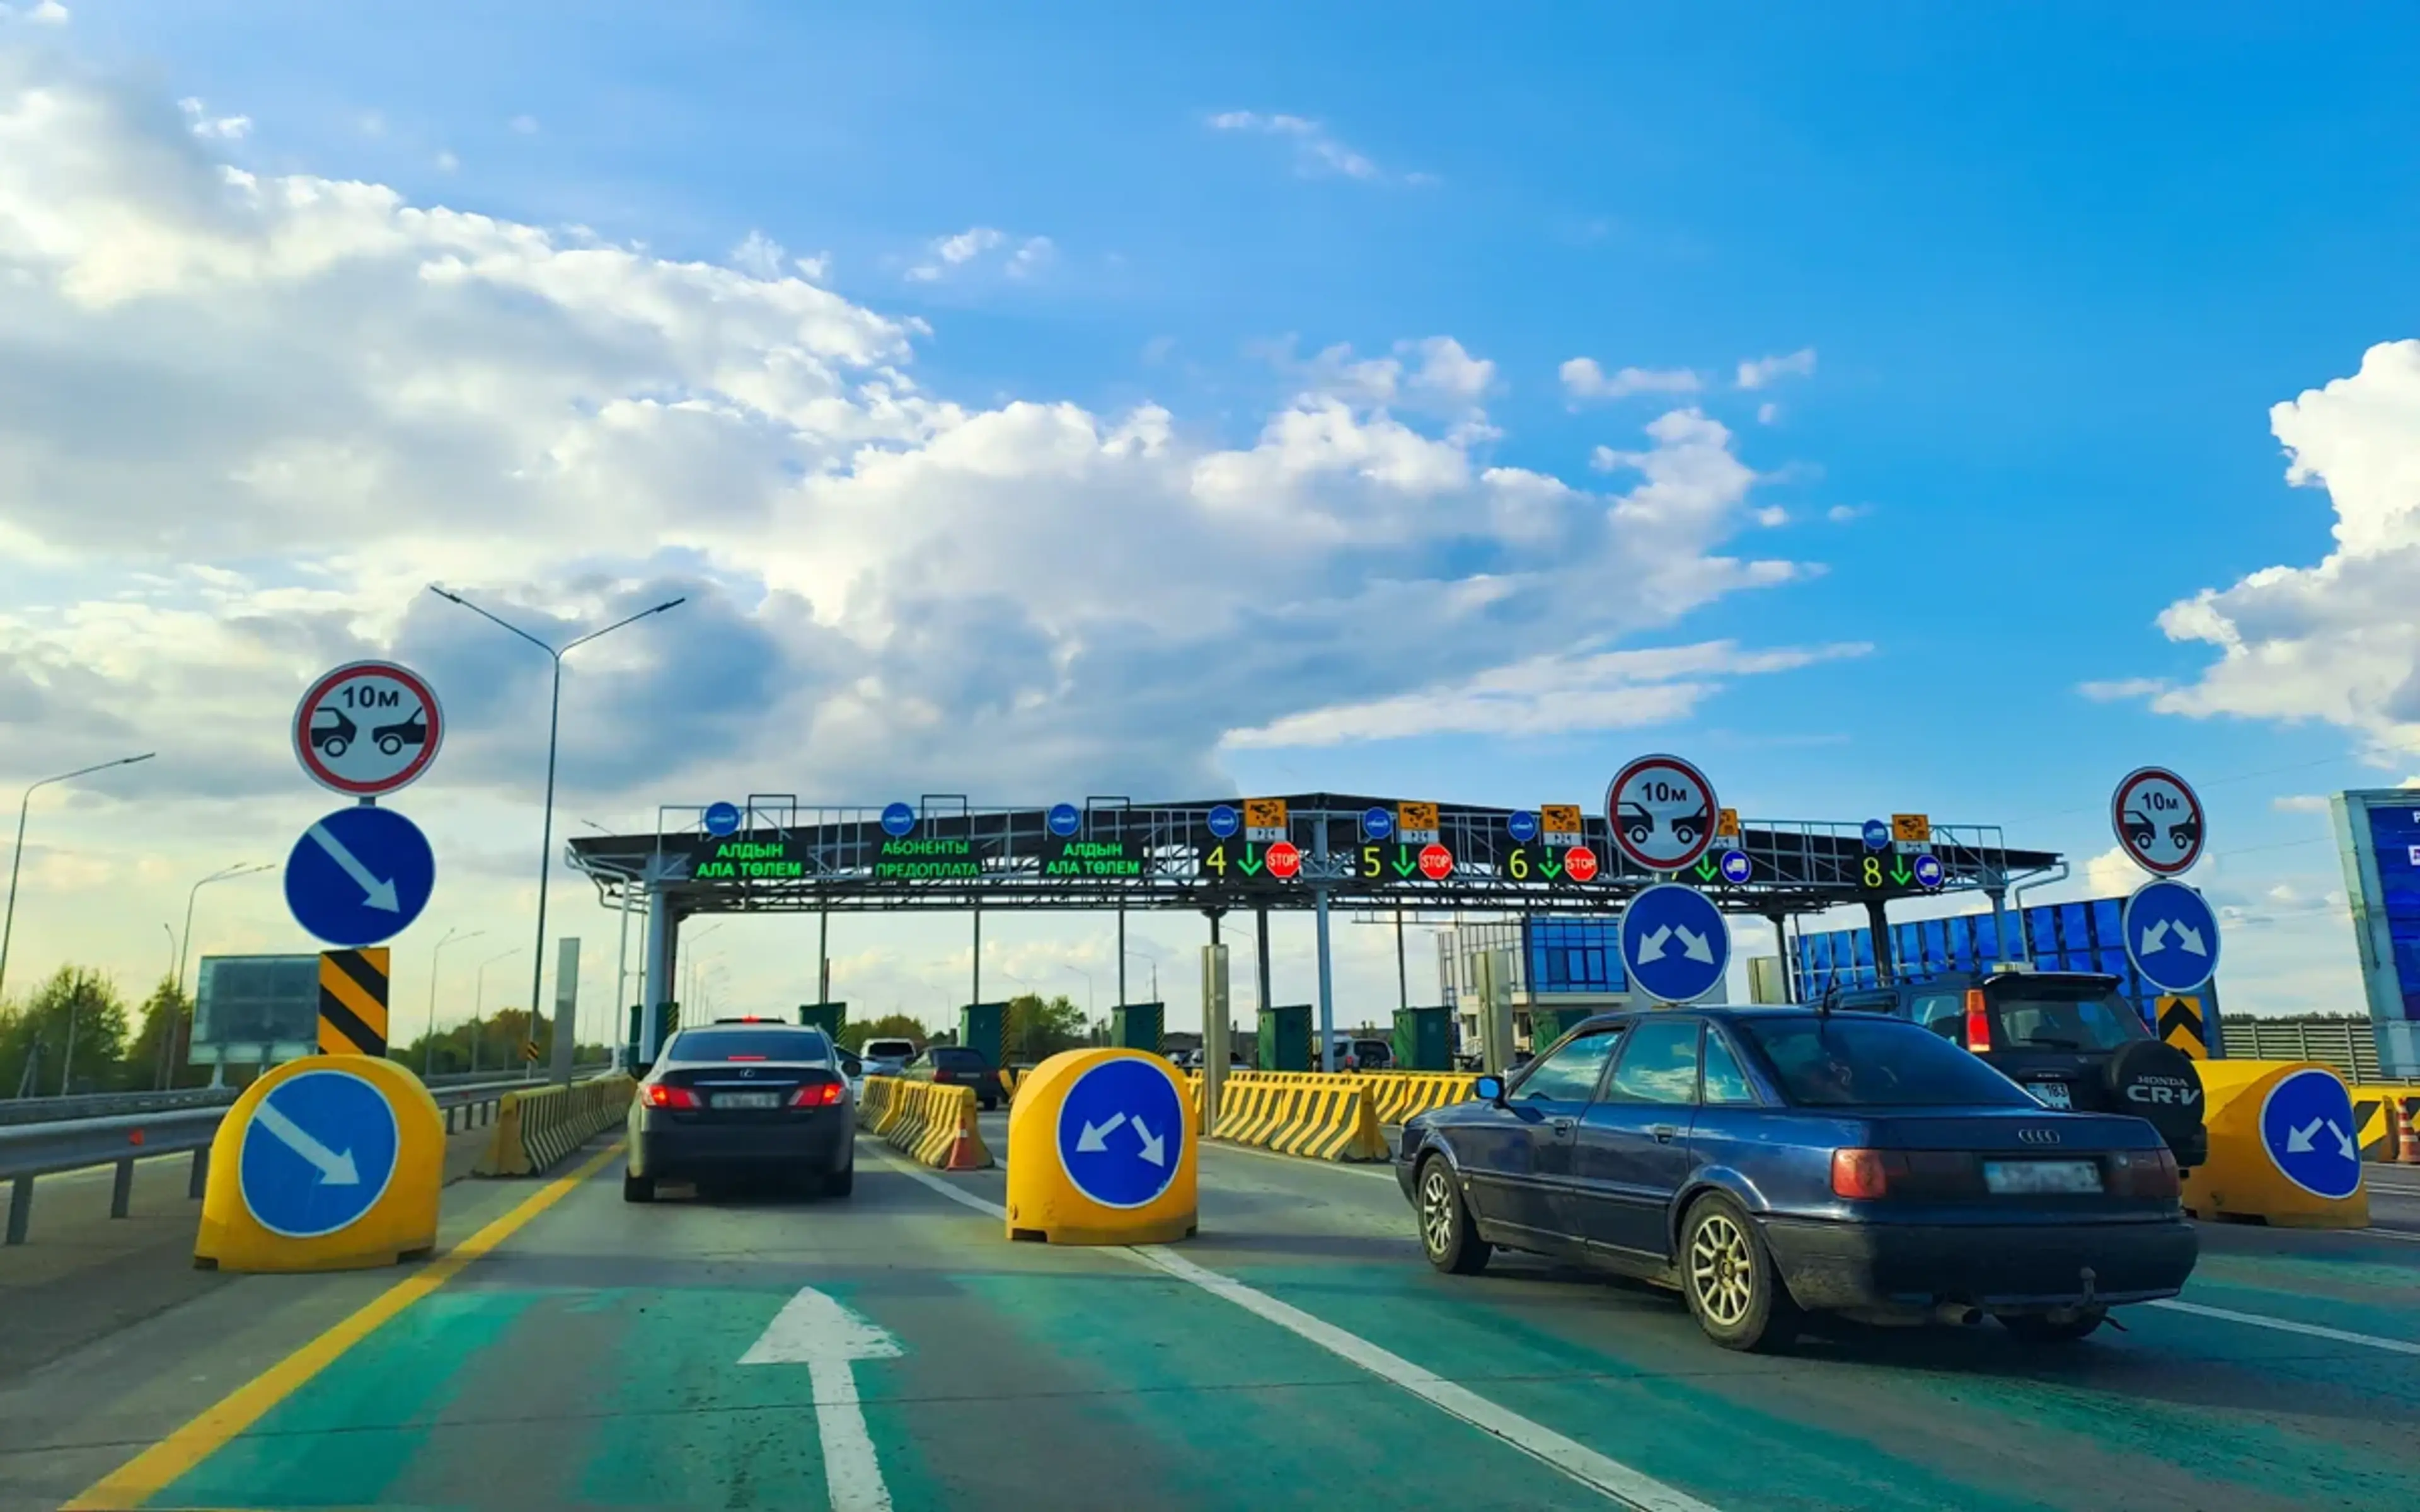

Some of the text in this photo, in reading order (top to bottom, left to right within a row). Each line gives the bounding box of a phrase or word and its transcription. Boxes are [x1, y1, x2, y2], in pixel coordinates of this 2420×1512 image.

[716, 842, 784, 859] АЛДЫН
[881, 840, 969, 856] АБОНЕНТЫ
[1063, 842, 1123, 859] АЛДЫН
[1046, 860, 1081, 875] АЛА
[1206, 845, 1226, 876] 4
[1268, 852, 1298, 868] STOP
[1363, 847, 1381, 877] 5
[1422, 854, 1449, 868] STOP
[1509, 849, 1528, 879] 6
[1565, 857, 1595, 870] STOP
[696, 861, 735, 878] АЛА
[875, 862, 980, 878] ПРЕДОПЛАТА
[1863, 856, 1882, 888] 8
[2137, 1075, 2189, 1087] HONDA
[2127, 1084, 2201, 1106] CR-V
